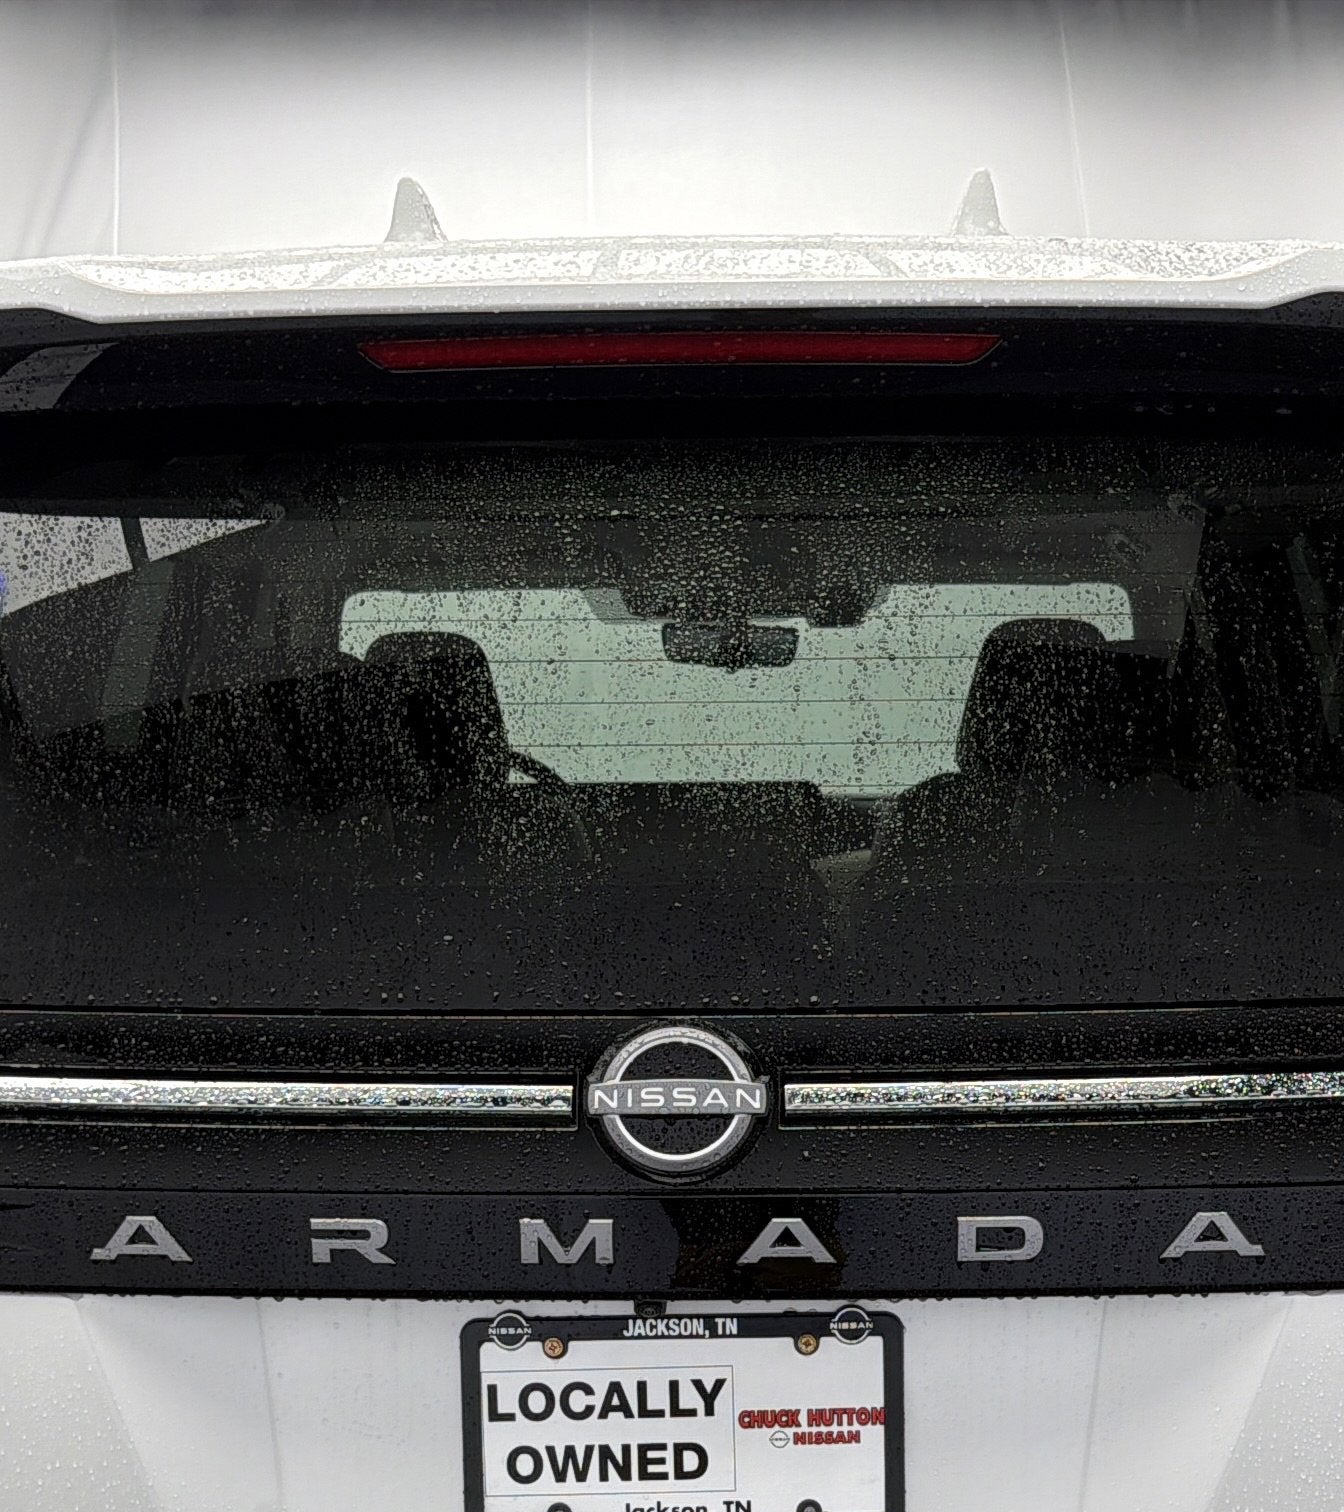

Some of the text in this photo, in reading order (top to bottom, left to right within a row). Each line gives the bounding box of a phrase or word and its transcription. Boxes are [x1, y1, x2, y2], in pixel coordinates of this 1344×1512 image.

[594, 1087, 761, 1109] NISSAN
[90, 1211, 1265, 1265] ARMADA
[488, 1327, 532, 1335] NISSAN
[623, 1317, 738, 1339] JACKSON, TN
[829, 1322, 874, 1330] NISSAN
[486, 1378, 727, 1423] LOCALLY
[738, 1407, 887, 1429] CHUCK HUTTON
[793, 1430, 861, 1445] NISSAN
[506, 1442, 709, 1485] OWNED
